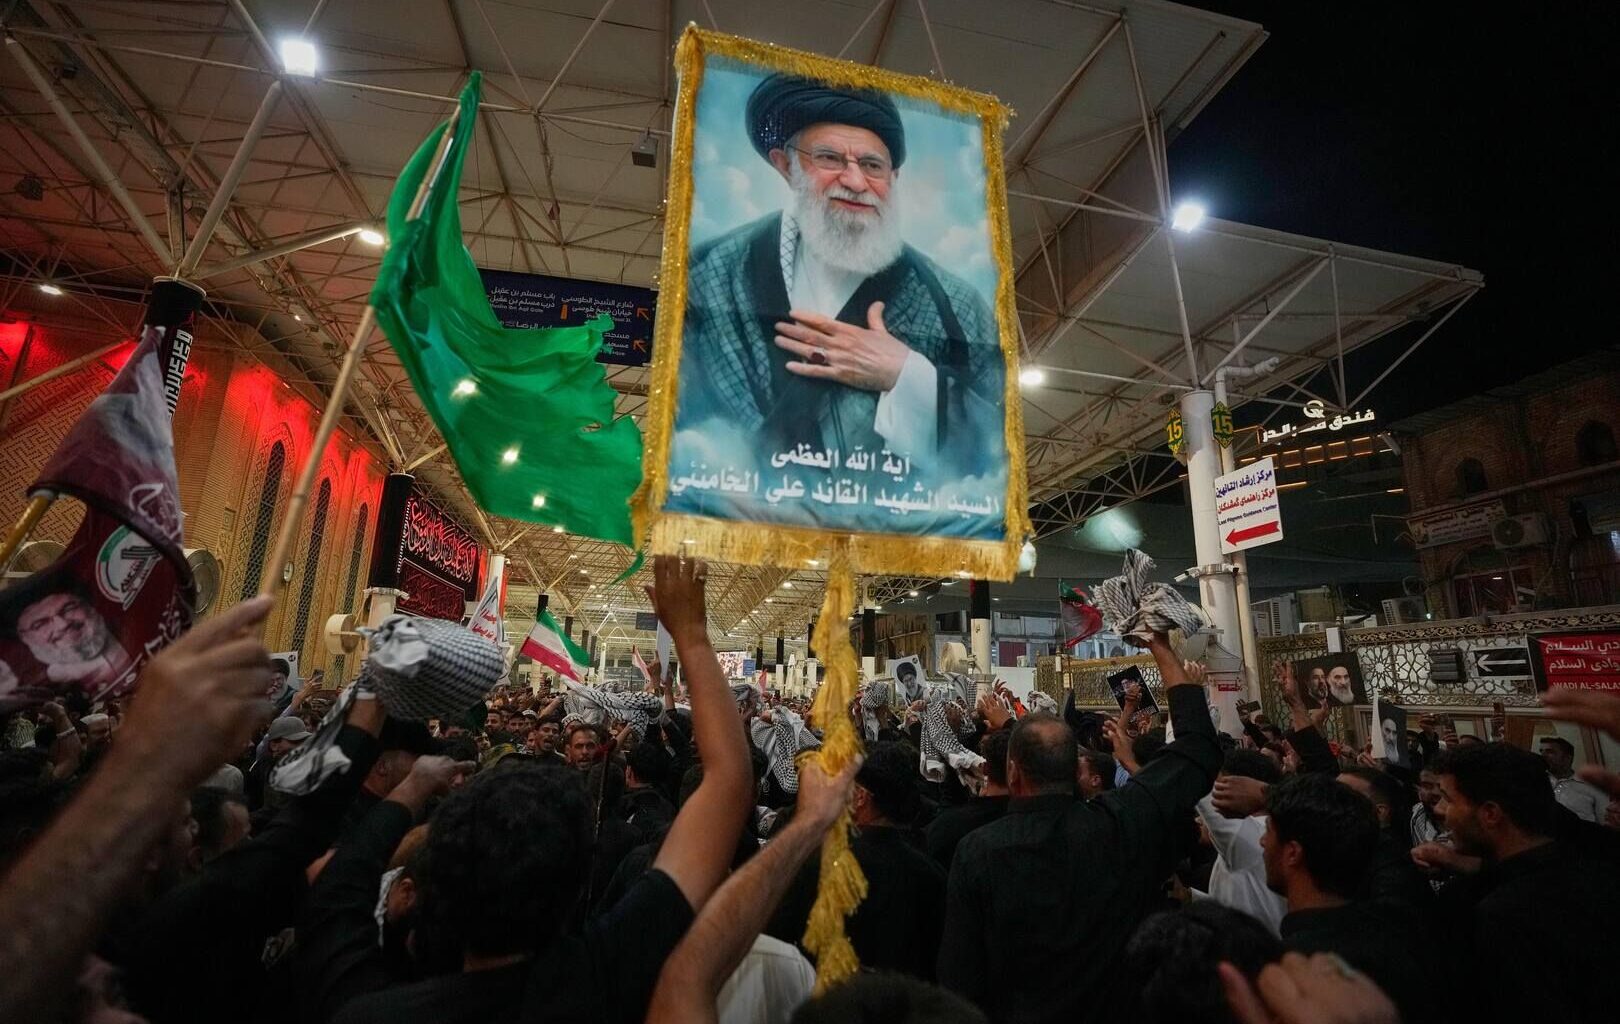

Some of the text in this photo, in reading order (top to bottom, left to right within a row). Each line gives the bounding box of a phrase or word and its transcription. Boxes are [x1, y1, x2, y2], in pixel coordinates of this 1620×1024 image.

[490, 286, 510, 295] عقيل
[510, 288, 520, 297] بن
[520, 290, 542, 299] مسلم
[508, 297, 518, 305] بن
[518, 298, 540, 307] مسلم
[540, 302, 555, 310] درب
[593, 298, 616, 306] الشيخ
[616, 301, 634, 309] شارع
[1213, 414, 1234, 434] 15
[1328, 408, 1375, 431] فندق
[1166, 418, 1183, 443] 15
[771, 442, 911, 482] آية الله العظمى
[1239, 475, 1256, 488] إرشاد
[1256, 469, 1273, 483] مركز
[669, 460, 1000, 519] السيد الشهيد القائد علي الخامنئي
[1545, 640, 1620, 655] دي السلام
[1549, 657, 1586, 673] السلام
[1552, 681, 1620, 690] WADI AL-SALA
